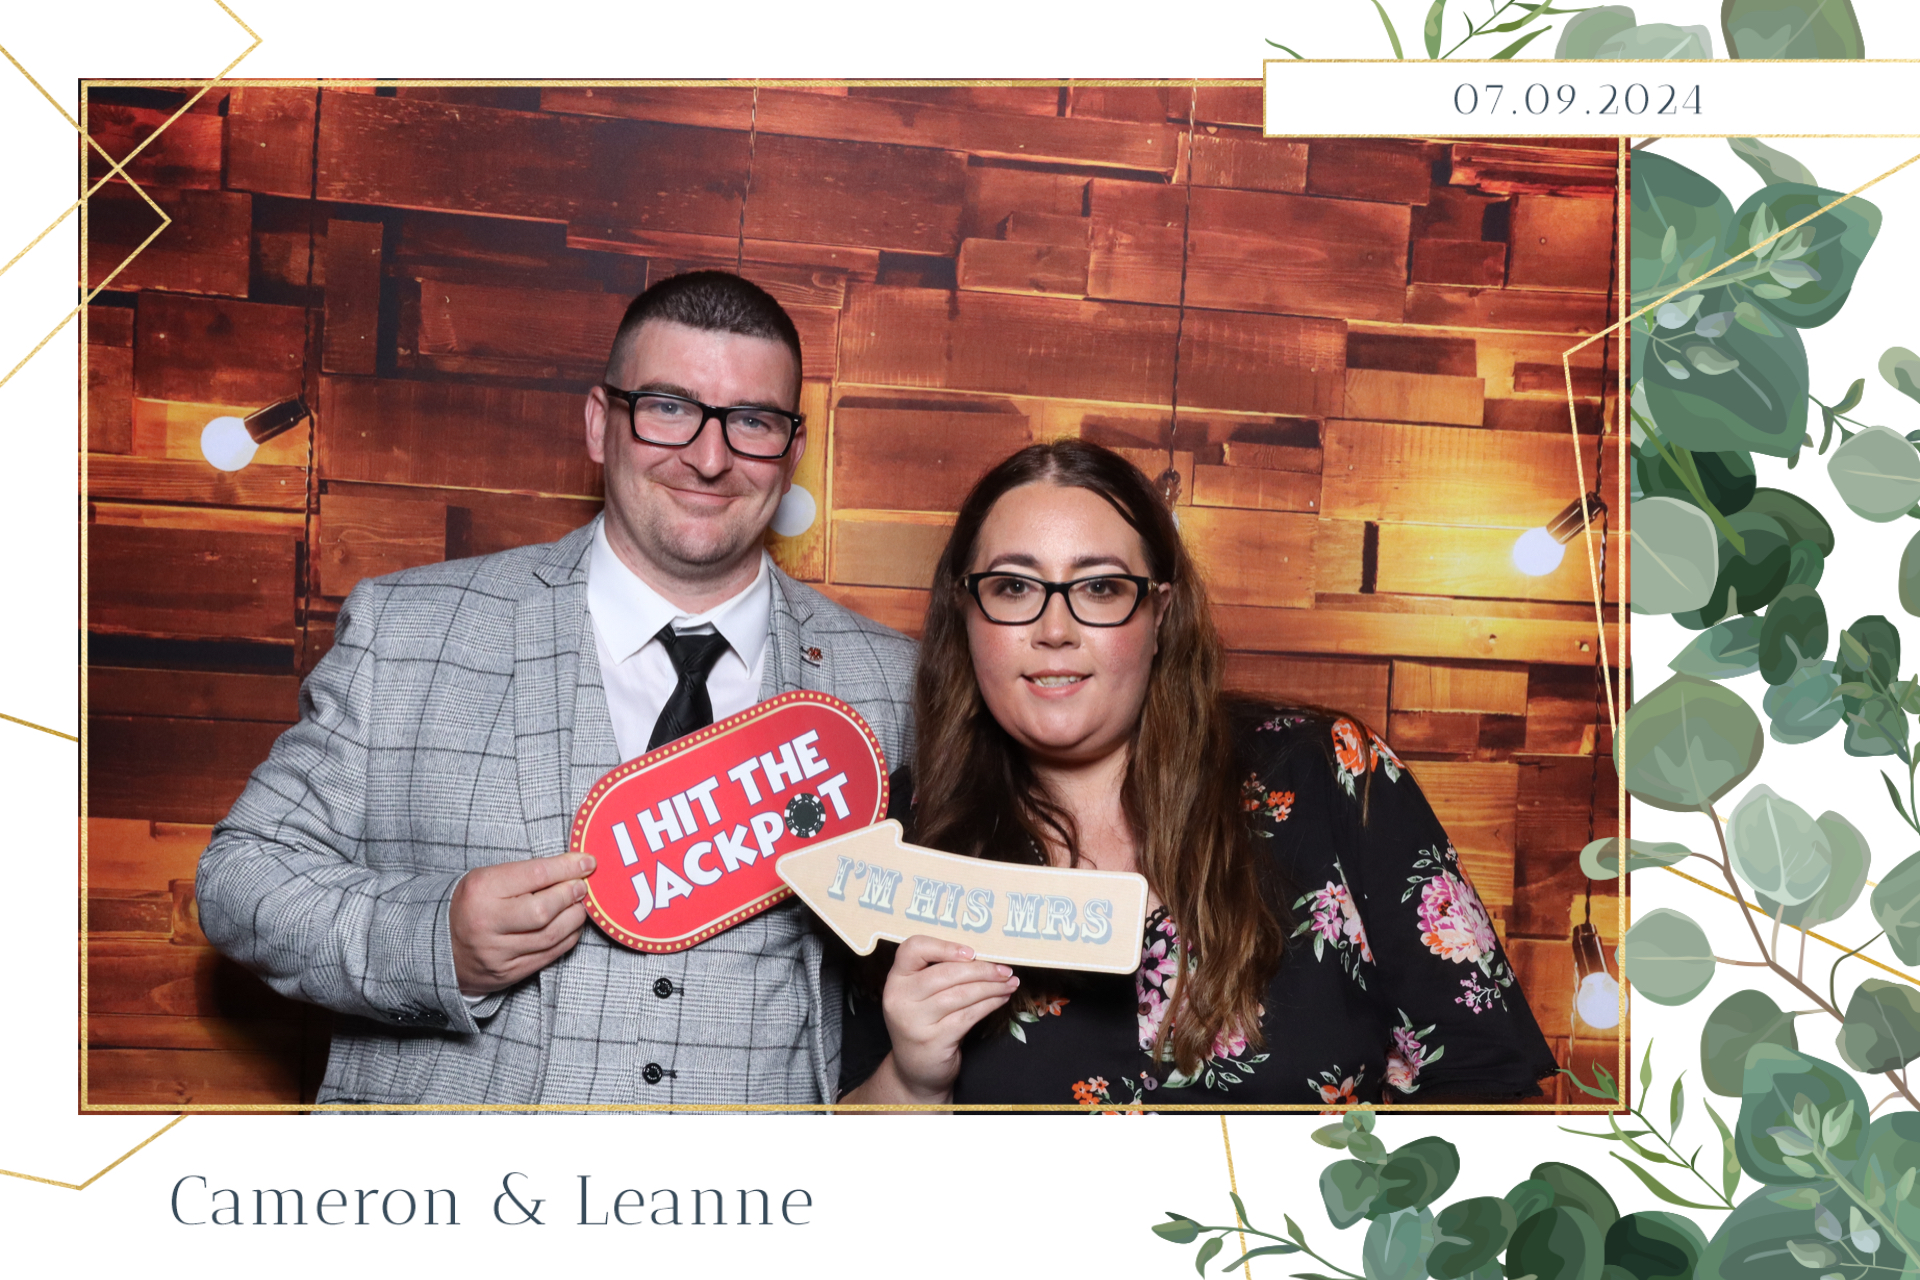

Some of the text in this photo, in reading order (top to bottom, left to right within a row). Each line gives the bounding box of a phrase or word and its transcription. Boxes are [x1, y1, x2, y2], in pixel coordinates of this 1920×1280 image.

[611, 729, 830, 867] I HIT THE
[630, 772, 851, 924] JACKPOT
[827, 855, 1112, 944] I'M HIS MRS
